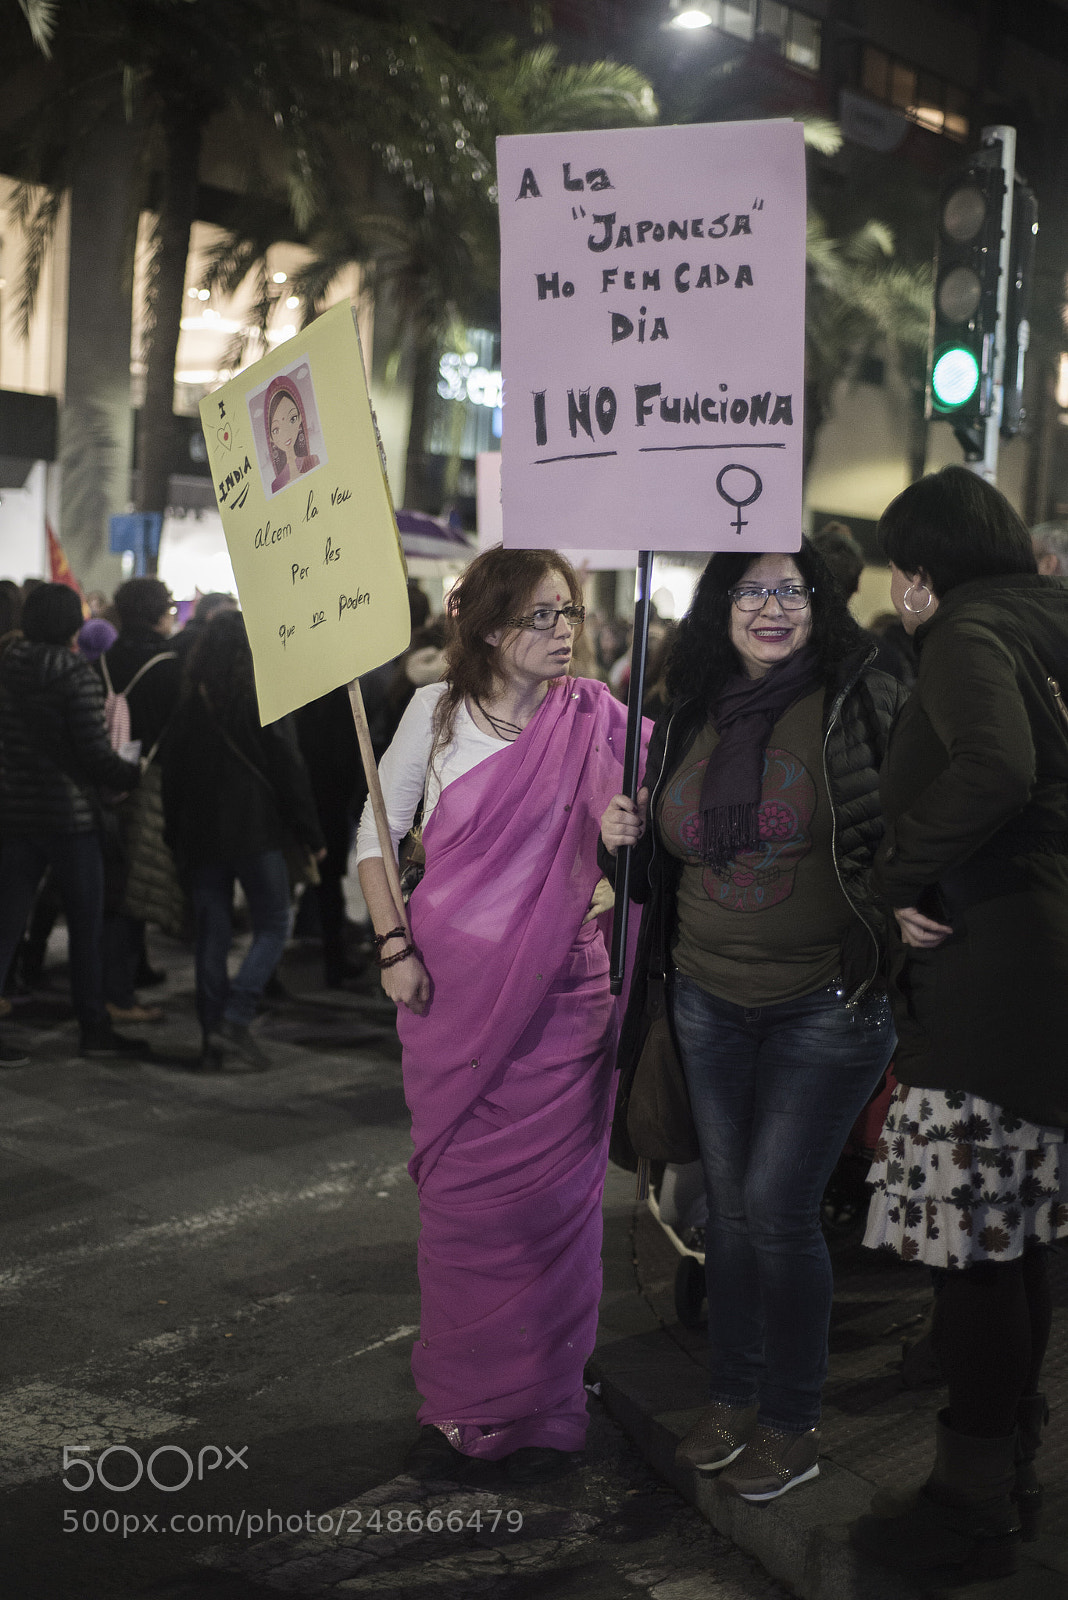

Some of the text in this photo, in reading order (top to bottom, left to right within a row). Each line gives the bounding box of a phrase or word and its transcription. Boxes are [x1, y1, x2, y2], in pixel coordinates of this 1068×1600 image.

[515, 162, 615, 201] A La
[600, 266, 661, 294] FEM
[674, 262, 754, 293] CADA
[218, 400, 226, 420] I
[530, 388, 548, 447] I
[566, 385, 618, 443] NO
[218, 455, 252, 503] INDIA
[302, 490, 319, 522] la
[323, 536, 342, 566] les
[278, 587, 371, 650] que no poden
